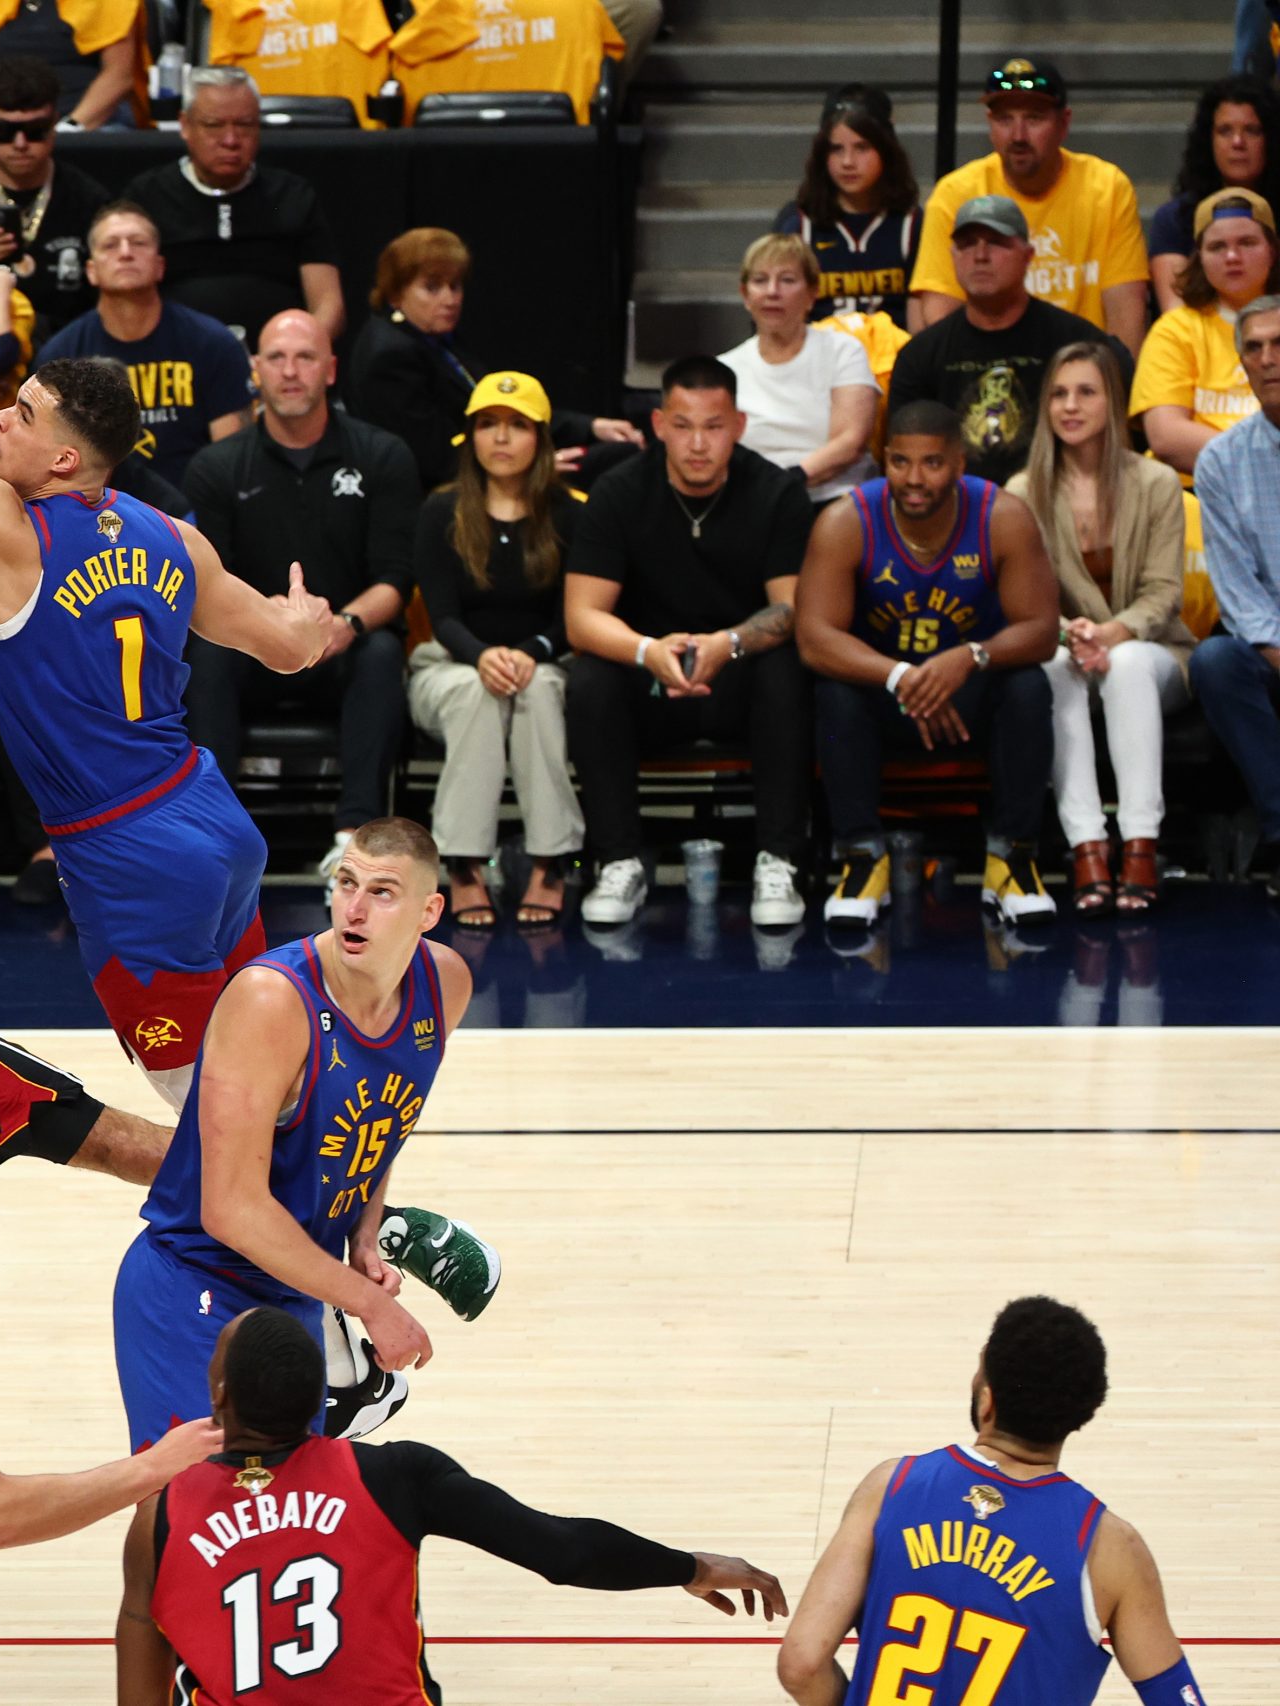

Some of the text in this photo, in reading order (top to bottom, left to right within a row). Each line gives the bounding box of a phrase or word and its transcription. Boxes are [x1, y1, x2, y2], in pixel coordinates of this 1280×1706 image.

[53, 547, 185, 619] PORTER JR.
[952, 553, 980, 568] WU
[113, 615, 144, 722] 1
[897, 617, 940, 654] 15
[319, 1011, 332, 1032] 6
[412, 1017, 435, 1037] WU
[319, 1077, 373, 1158] MILE
[346, 1117, 394, 1179] 15
[327, 1177, 373, 1219] CITY
[188, 1490, 348, 1569] ADEBAYO
[901, 1519, 1057, 1603] MURRAY
[222, 1553, 342, 1696] 13
[867, 1592, 1029, 1706] 27
